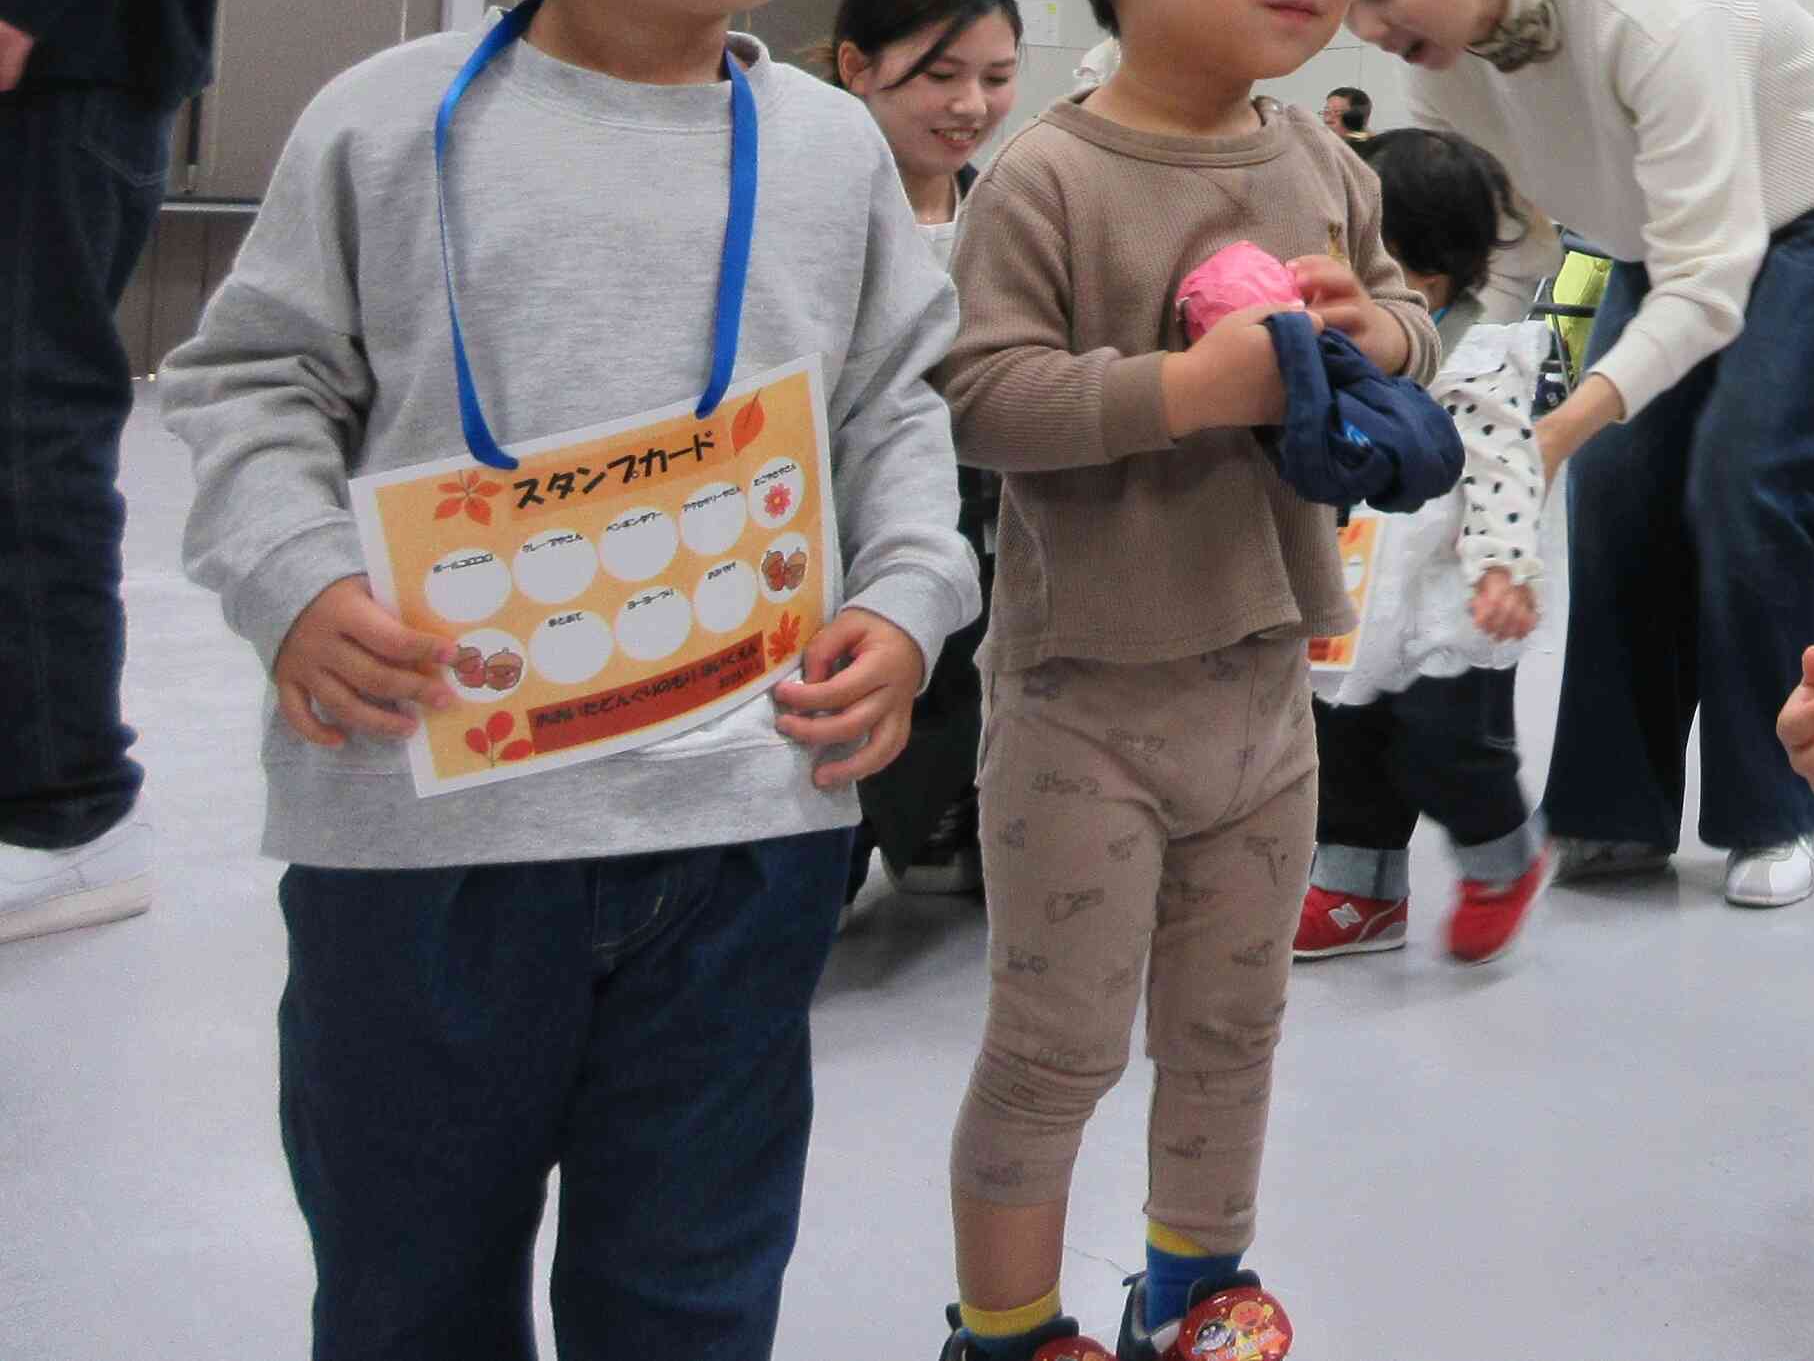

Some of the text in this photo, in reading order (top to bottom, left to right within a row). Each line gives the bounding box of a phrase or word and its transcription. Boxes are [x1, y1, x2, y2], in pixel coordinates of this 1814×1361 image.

[511, 430, 716, 510] スタンプカード
